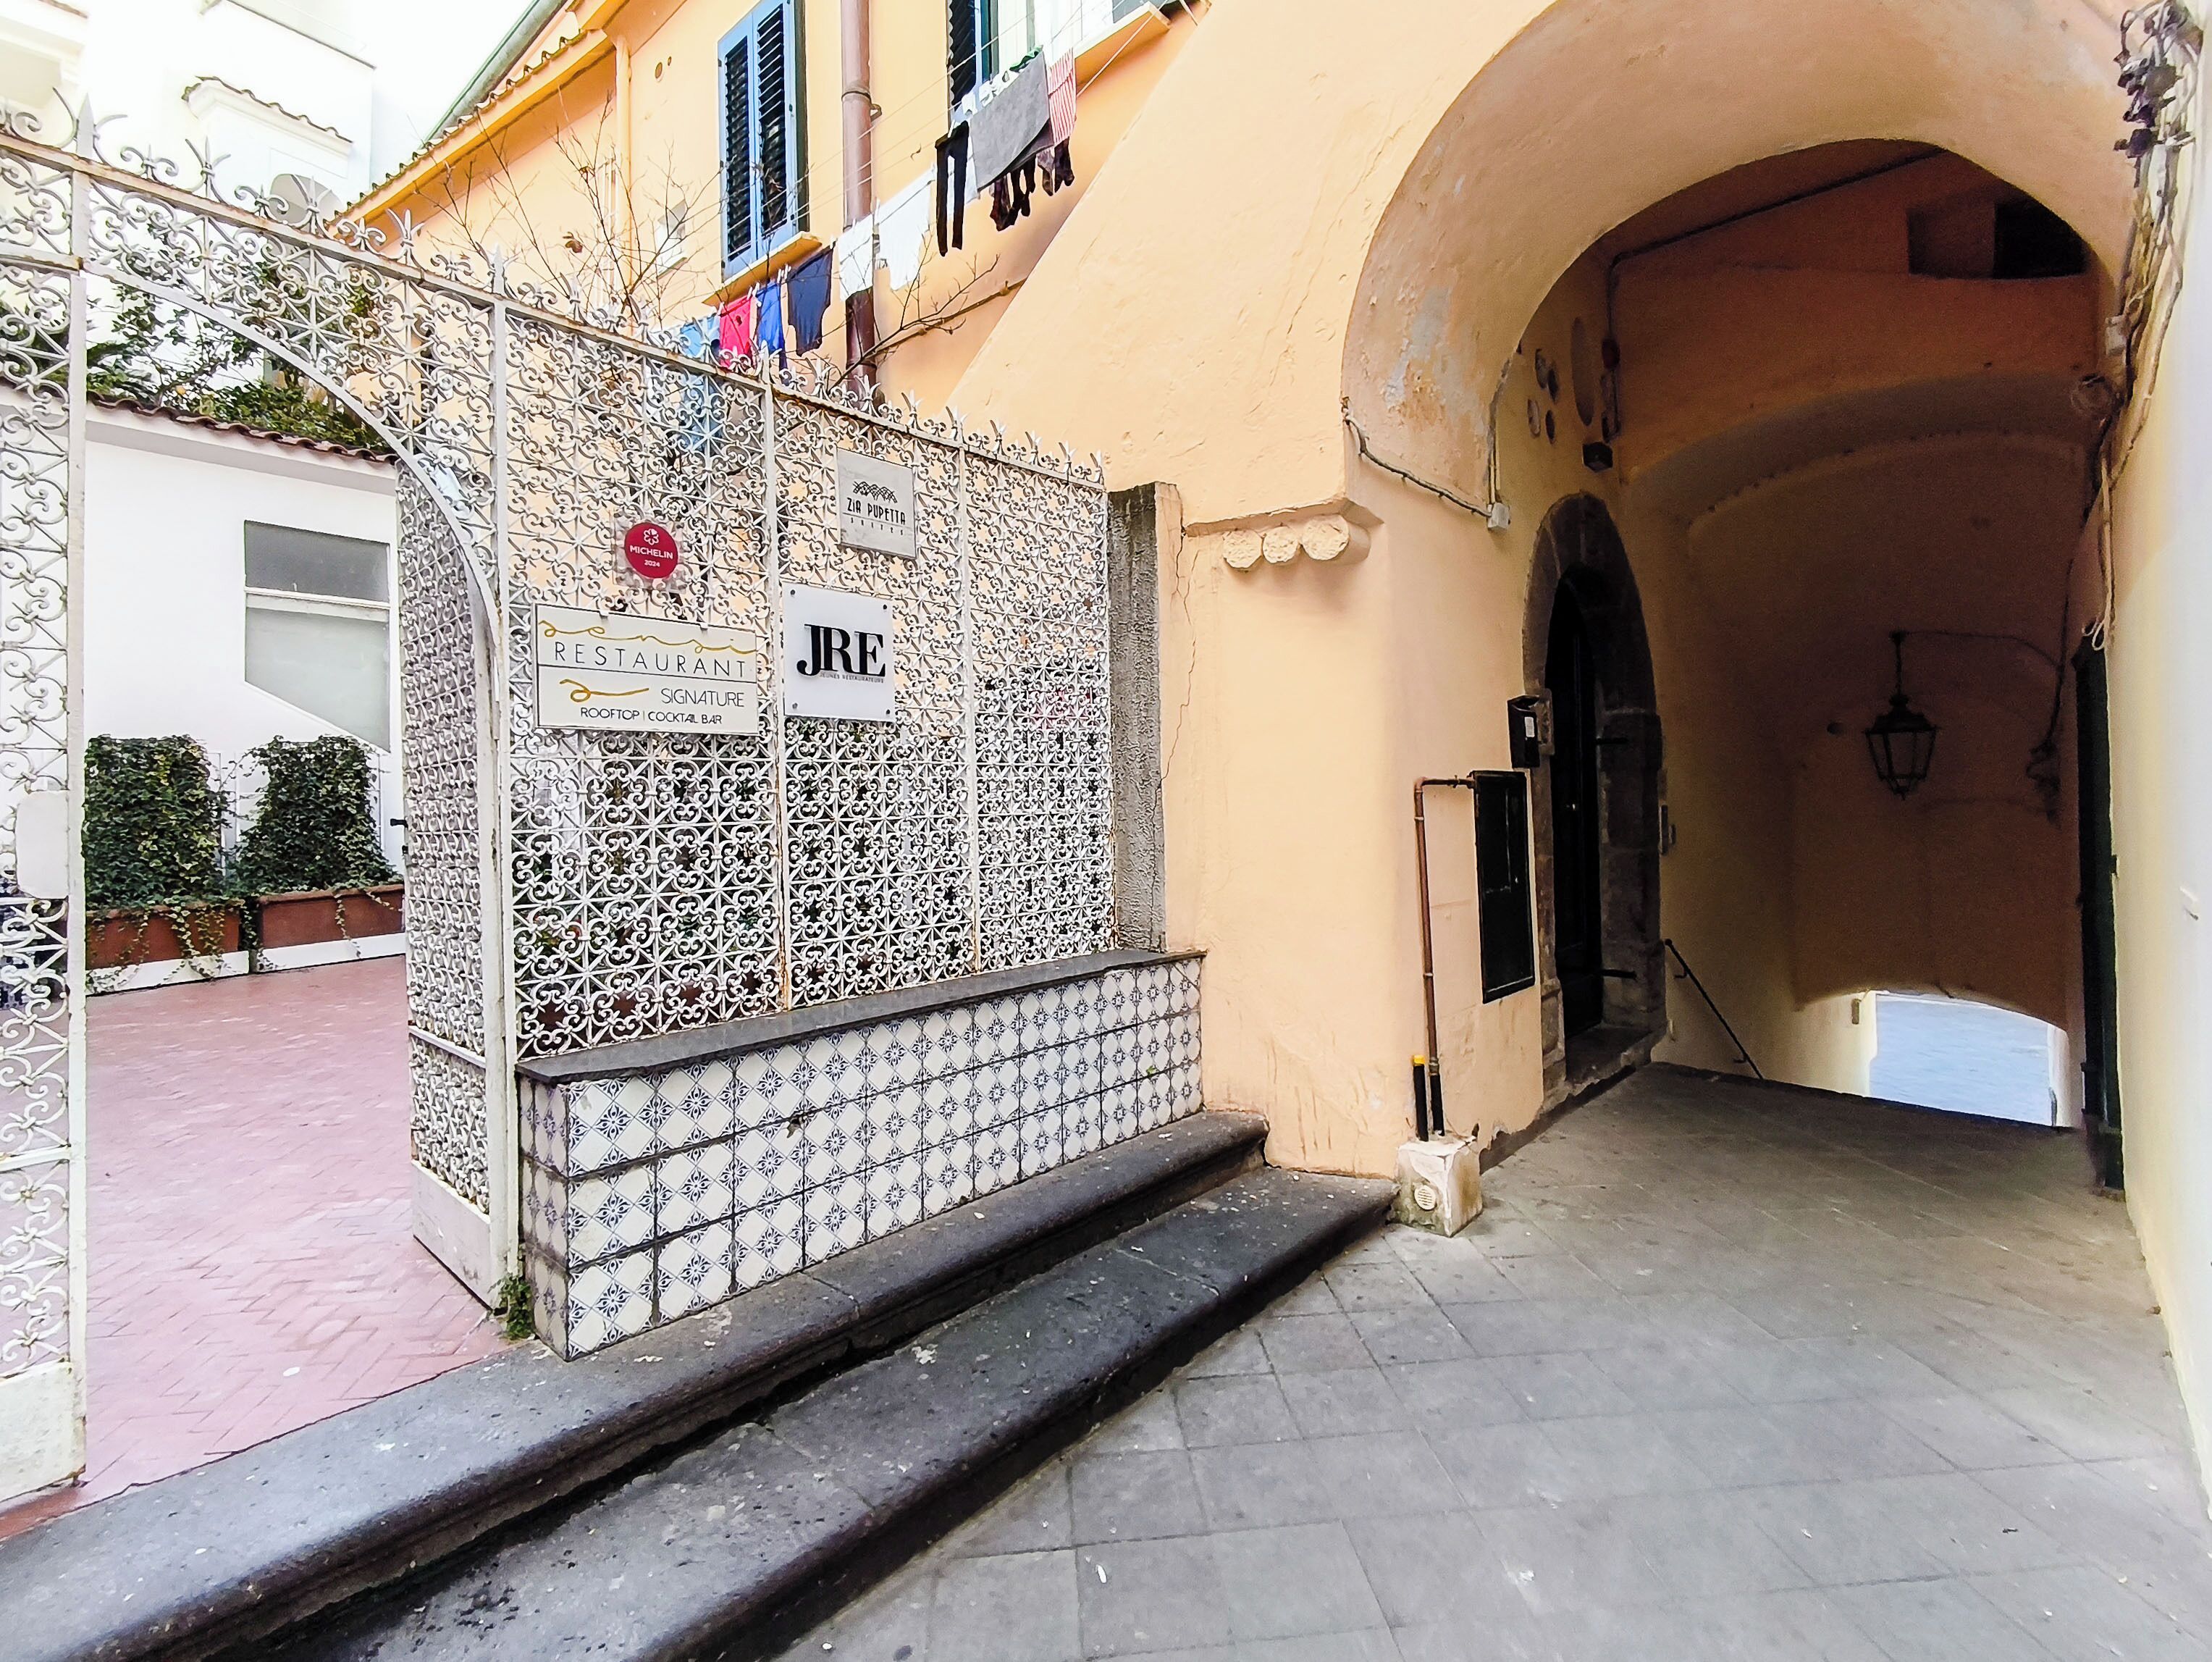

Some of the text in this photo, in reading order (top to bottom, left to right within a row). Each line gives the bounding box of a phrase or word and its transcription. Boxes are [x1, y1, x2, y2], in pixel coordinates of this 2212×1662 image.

[867, 502, 906, 526] PUPETTA
[629, 545, 673, 560] MICHELIN
[555, 641, 746, 678] RESTAURANT
[796, 624, 886, 677] JRE
[660, 687, 744, 708] SIGNATURE
[581, 707, 722, 725] ROOFTOP COCKTAIL BAR
